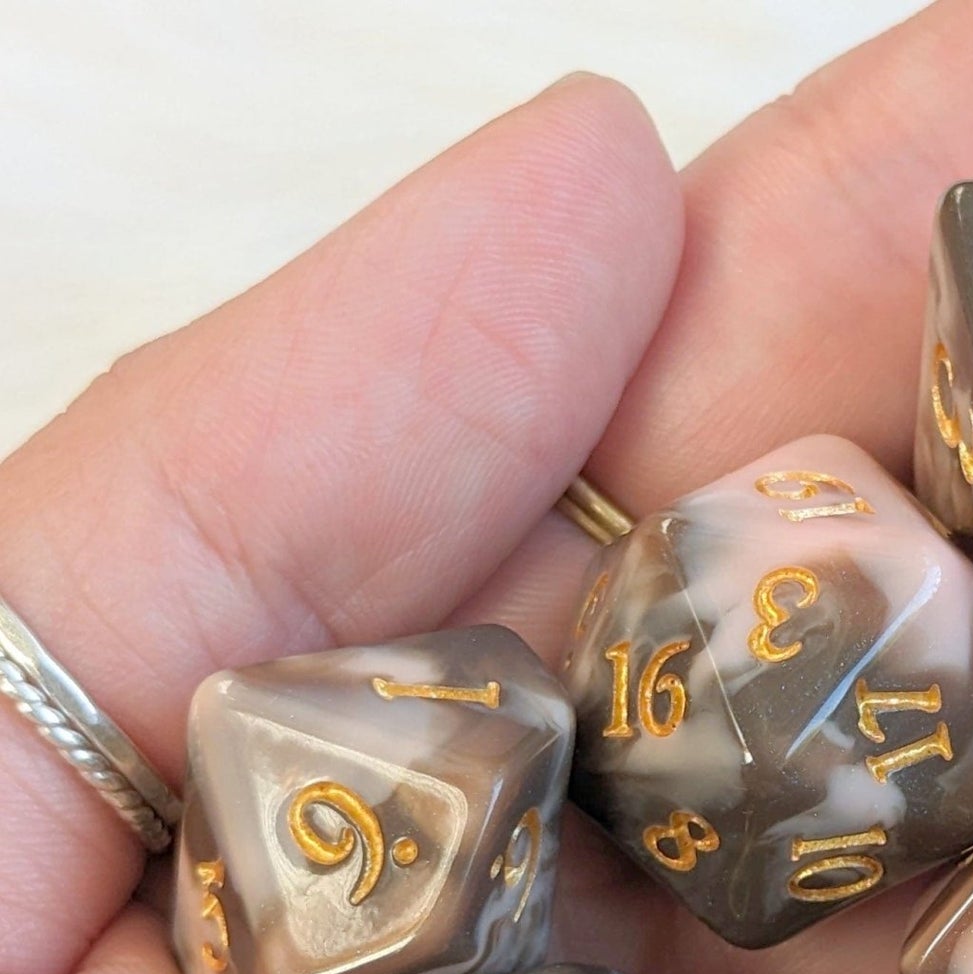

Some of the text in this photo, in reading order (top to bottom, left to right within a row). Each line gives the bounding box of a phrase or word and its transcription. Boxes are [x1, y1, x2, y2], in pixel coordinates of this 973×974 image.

[747, 566, 820, 664] 3
[372, 677, 501, 709] 1
[602, 638, 692, 739] 16
[856, 677, 953, 785] 17
[642, 810, 721, 872] 8
[787, 825, 887, 901] 10
